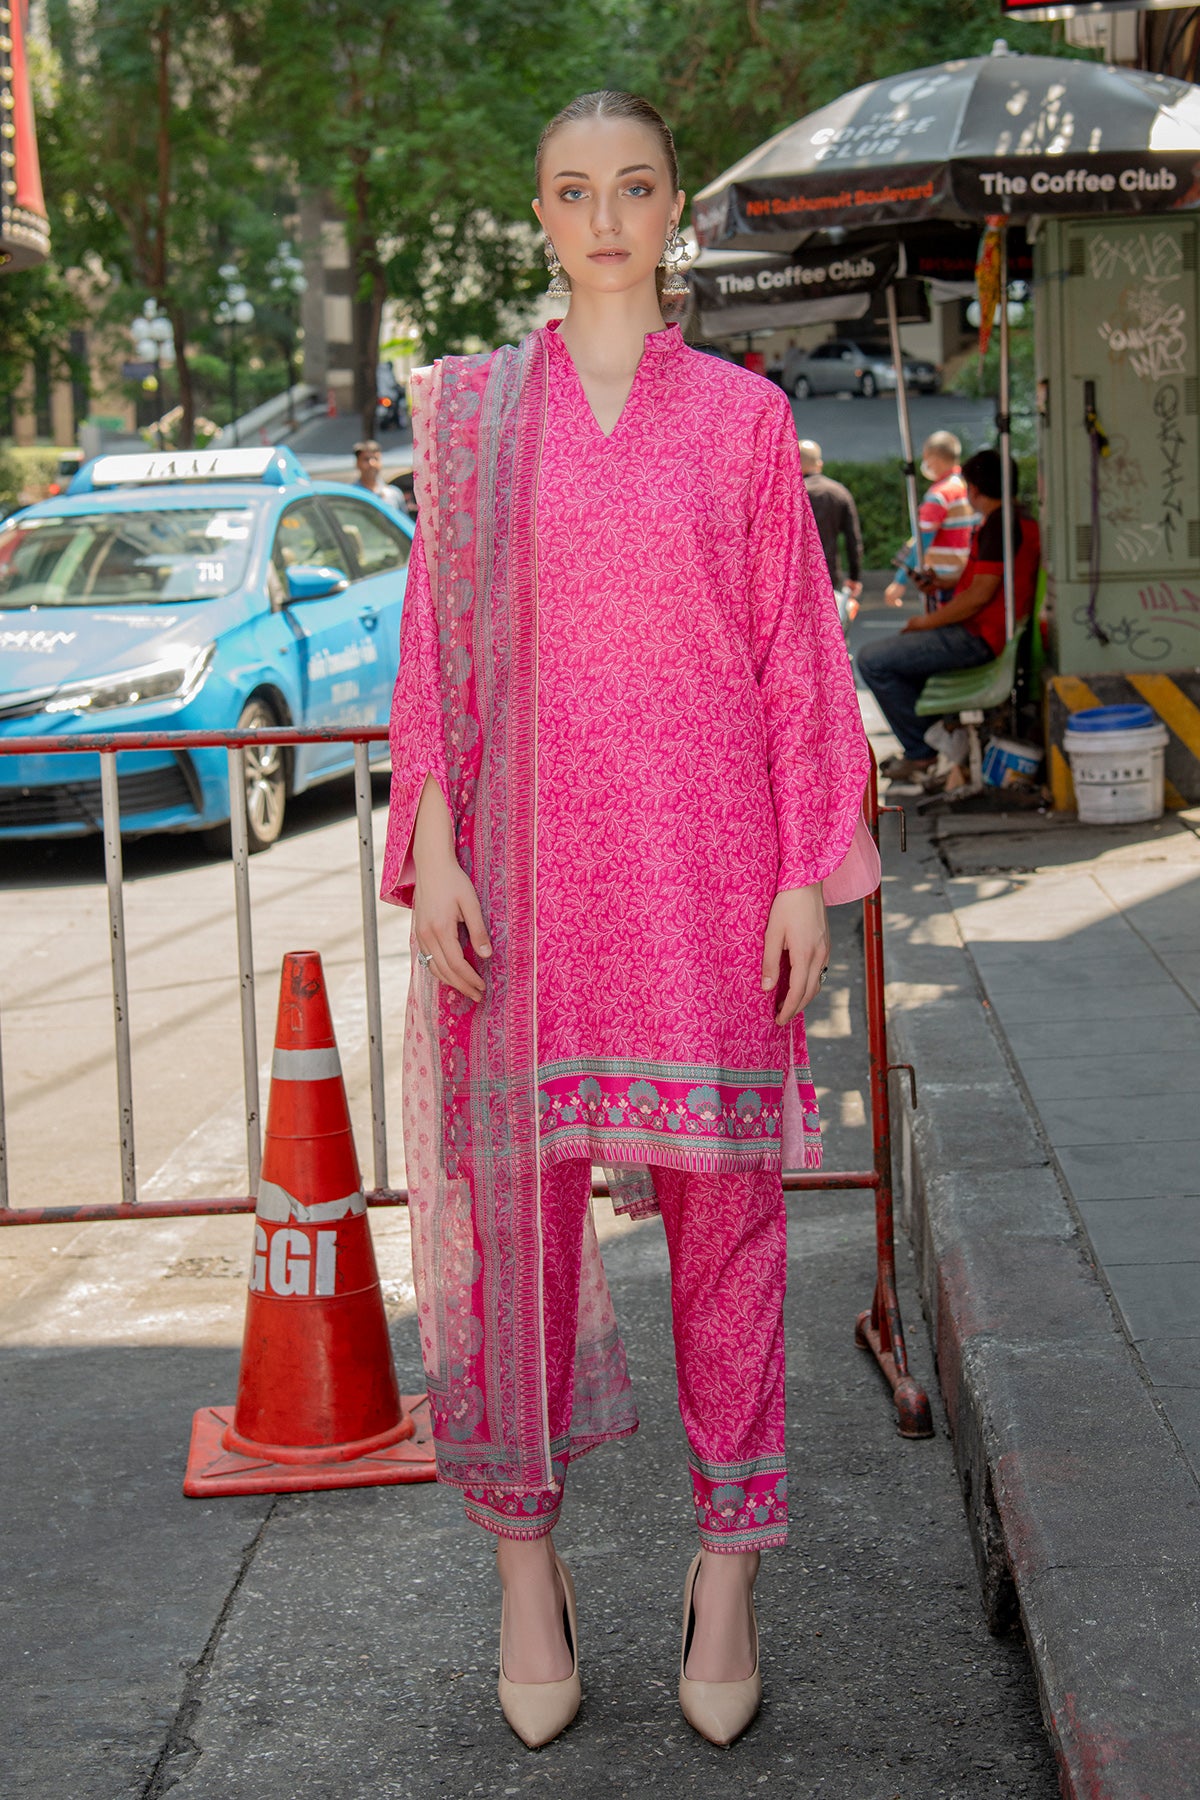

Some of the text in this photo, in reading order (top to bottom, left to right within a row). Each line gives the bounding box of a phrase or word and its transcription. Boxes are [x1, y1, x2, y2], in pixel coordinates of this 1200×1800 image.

[809, 115, 937, 145] COFFEE
[814, 137, 901, 161] CLUB
[979, 167, 1177, 195] The Coffee Club
[771, 191, 851, 215] Sukhumvit
[854, 180, 934, 205] Boulevard
[715, 257, 875, 295] The Coffee Club
